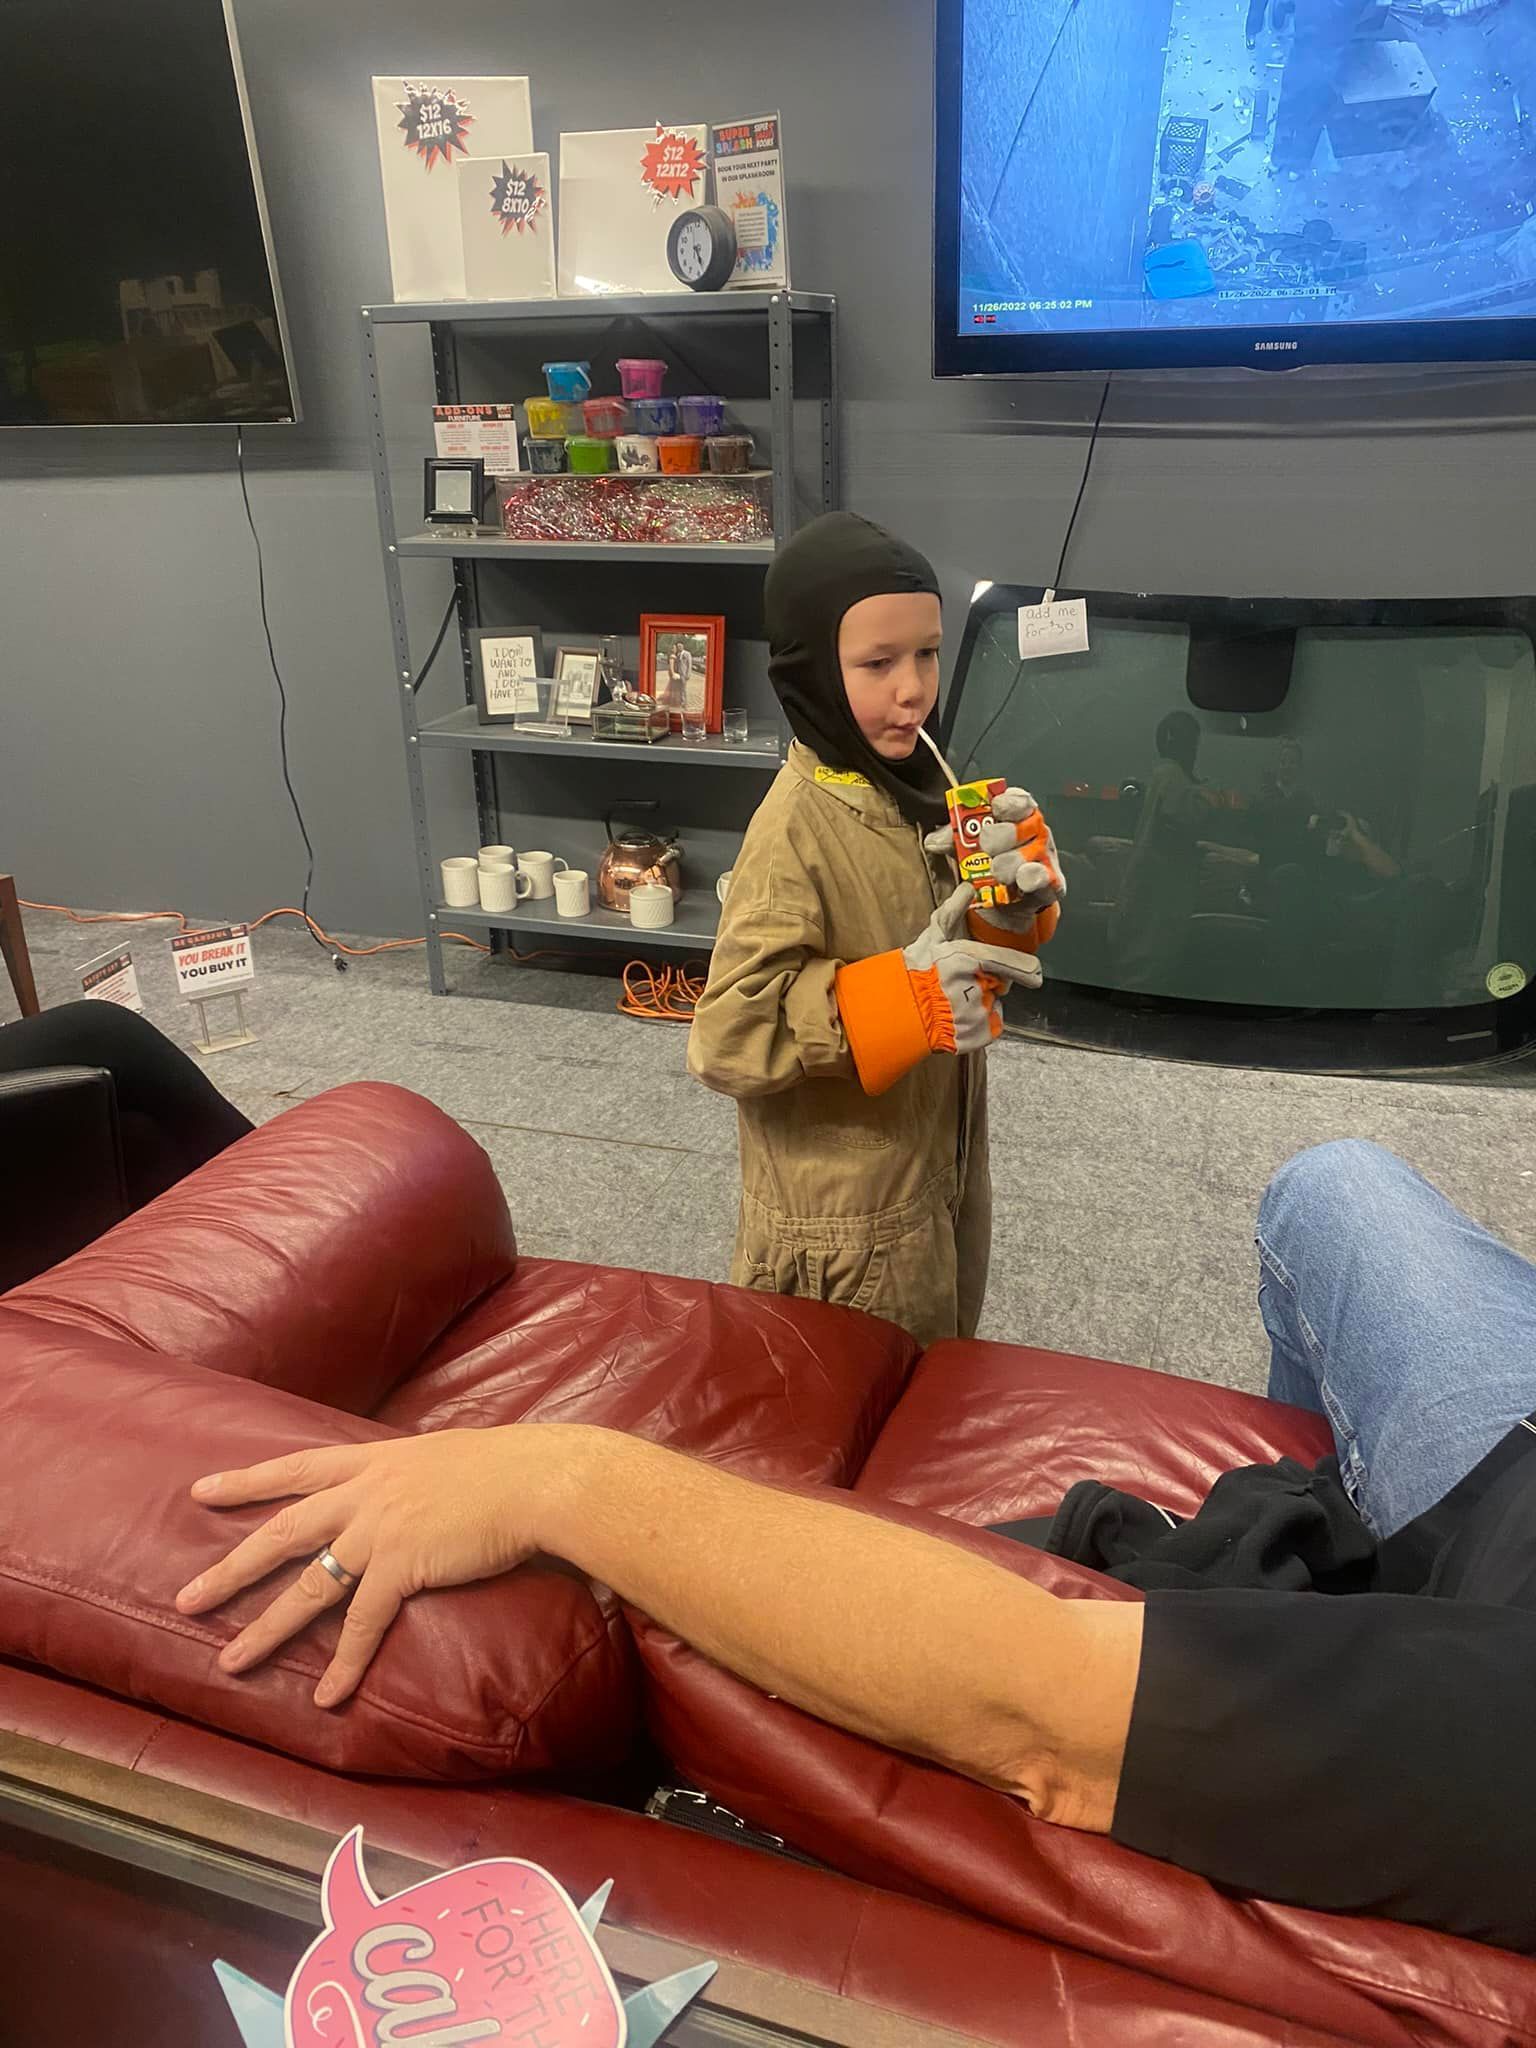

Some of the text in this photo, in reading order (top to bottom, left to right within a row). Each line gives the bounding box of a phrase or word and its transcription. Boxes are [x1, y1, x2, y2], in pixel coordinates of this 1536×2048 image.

[420, 103, 441, 123] $12
[417, 119, 452, 140] 12X16
[664, 145, 685, 161] $12
[715, 137, 753, 154] SPLASH
[656, 163, 690, 178] 12X12
[506, 180, 526, 197] $12
[502, 197, 529, 213] 8X10
[972, 299, 1093, 312] 11/26/2022 06:25:02 PM
[1254, 341, 1298, 351] SAMSUNG
[1026, 607, 1078, 619] add me
[1026, 623, 1049, 639] for
[490, 657, 533, 669] WANT TO
[498, 669, 516, 679] AND
[490, 688, 512, 700] HAVE
[179, 943, 246, 967] YOU BREAK IT
[180, 966, 207, 980] YOU
[209, 960, 234, 974] BUY
[236, 958, 247, 968] IT
[963, 985, 974, 1002] L
[461, 1897, 527, 1992] FOR
[522, 1910, 597, 2016] HERE
